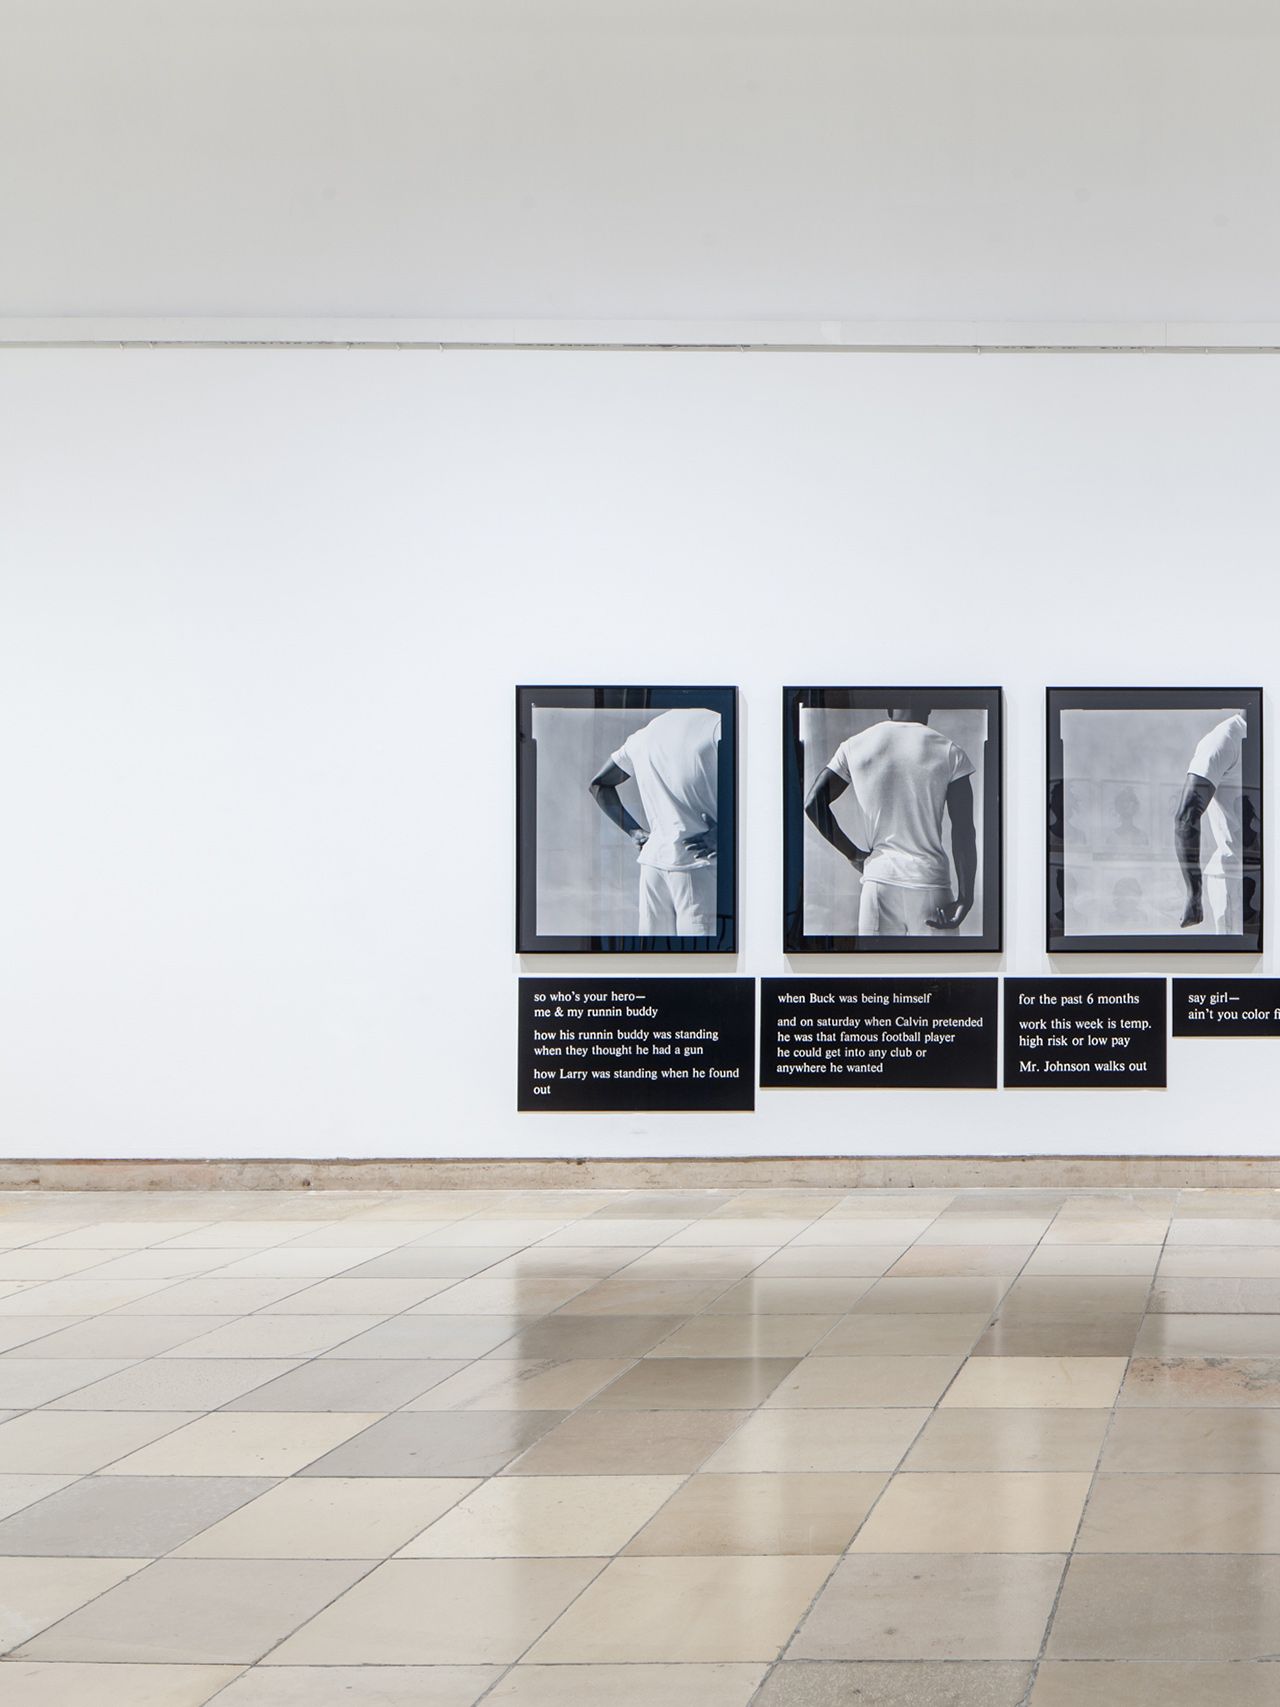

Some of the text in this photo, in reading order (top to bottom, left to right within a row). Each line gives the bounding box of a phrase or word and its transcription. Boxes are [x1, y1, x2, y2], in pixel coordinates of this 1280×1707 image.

[549, 991, 581, 1001] who's
[583, 994, 608, 1003] your
[777, 993, 806, 1003] when
[809, 993, 836, 1003] Buck
[861, 993, 890, 1005] being
[892, 993, 933, 1003] himself
[1018, 993, 1140, 1006] for the past 6 months
[1188, 995, 1207, 1005] say
[533, 1006, 659, 1018] me & my runnin buddy
[1188, 1008, 1214, 1019] ain't
[1217, 1011, 1239, 1021] you
[1241, 1009, 1271, 1019] color
[777, 1017, 797, 1026] and
[816, 1017, 861, 1028] saturday
[863, 1017, 892, 1026] when
[894, 1017, 929, 1026] Calvin
[932, 1017, 984, 1028] pretended
[1018, 1018, 1152, 1030] work this week is temp.
[533, 1030, 557, 1040] how
[559, 1030, 576, 1040] his
[578, 1030, 614, 1040] runnin
[616, 1029, 650, 1041] buddy
[674, 1029, 719, 1041] standing
[777, 1032, 791, 1042] he
[816, 1032, 837, 1041] that
[840, 1032, 879, 1041] famous
[881, 1032, 921, 1042] football
[924, 1032, 956, 1044] player
[1018, 1035, 1131, 1048] high risk or low pay
[533, 1045, 562, 1055] when
[565, 1045, 589, 1057] they
[591, 1045, 633, 1057] thought
[635, 1045, 649, 1054] he
[652, 1045, 672, 1054] had
[683, 1047, 704, 1056] gun
[777, 1047, 791, 1057] he
[792, 1047, 822, 1057] could
[824, 1049, 841, 1059] get
[844, 1047, 866, 1057] into
[868, 1050, 888, 1059] any
[889, 1047, 913, 1057] club
[776, 1063, 884, 1074] anywhere he wanted
[1019, 1061, 1148, 1072] Mr. Johnson walks out
[533, 1069, 557, 1079] how
[559, 1069, 589, 1080] Larry
[613, 1068, 658, 1080] standing
[660, 1068, 689, 1078] when
[692, 1068, 706, 1078] he
[708, 1068, 740, 1078] found
[532, 1086, 552, 1094] out
